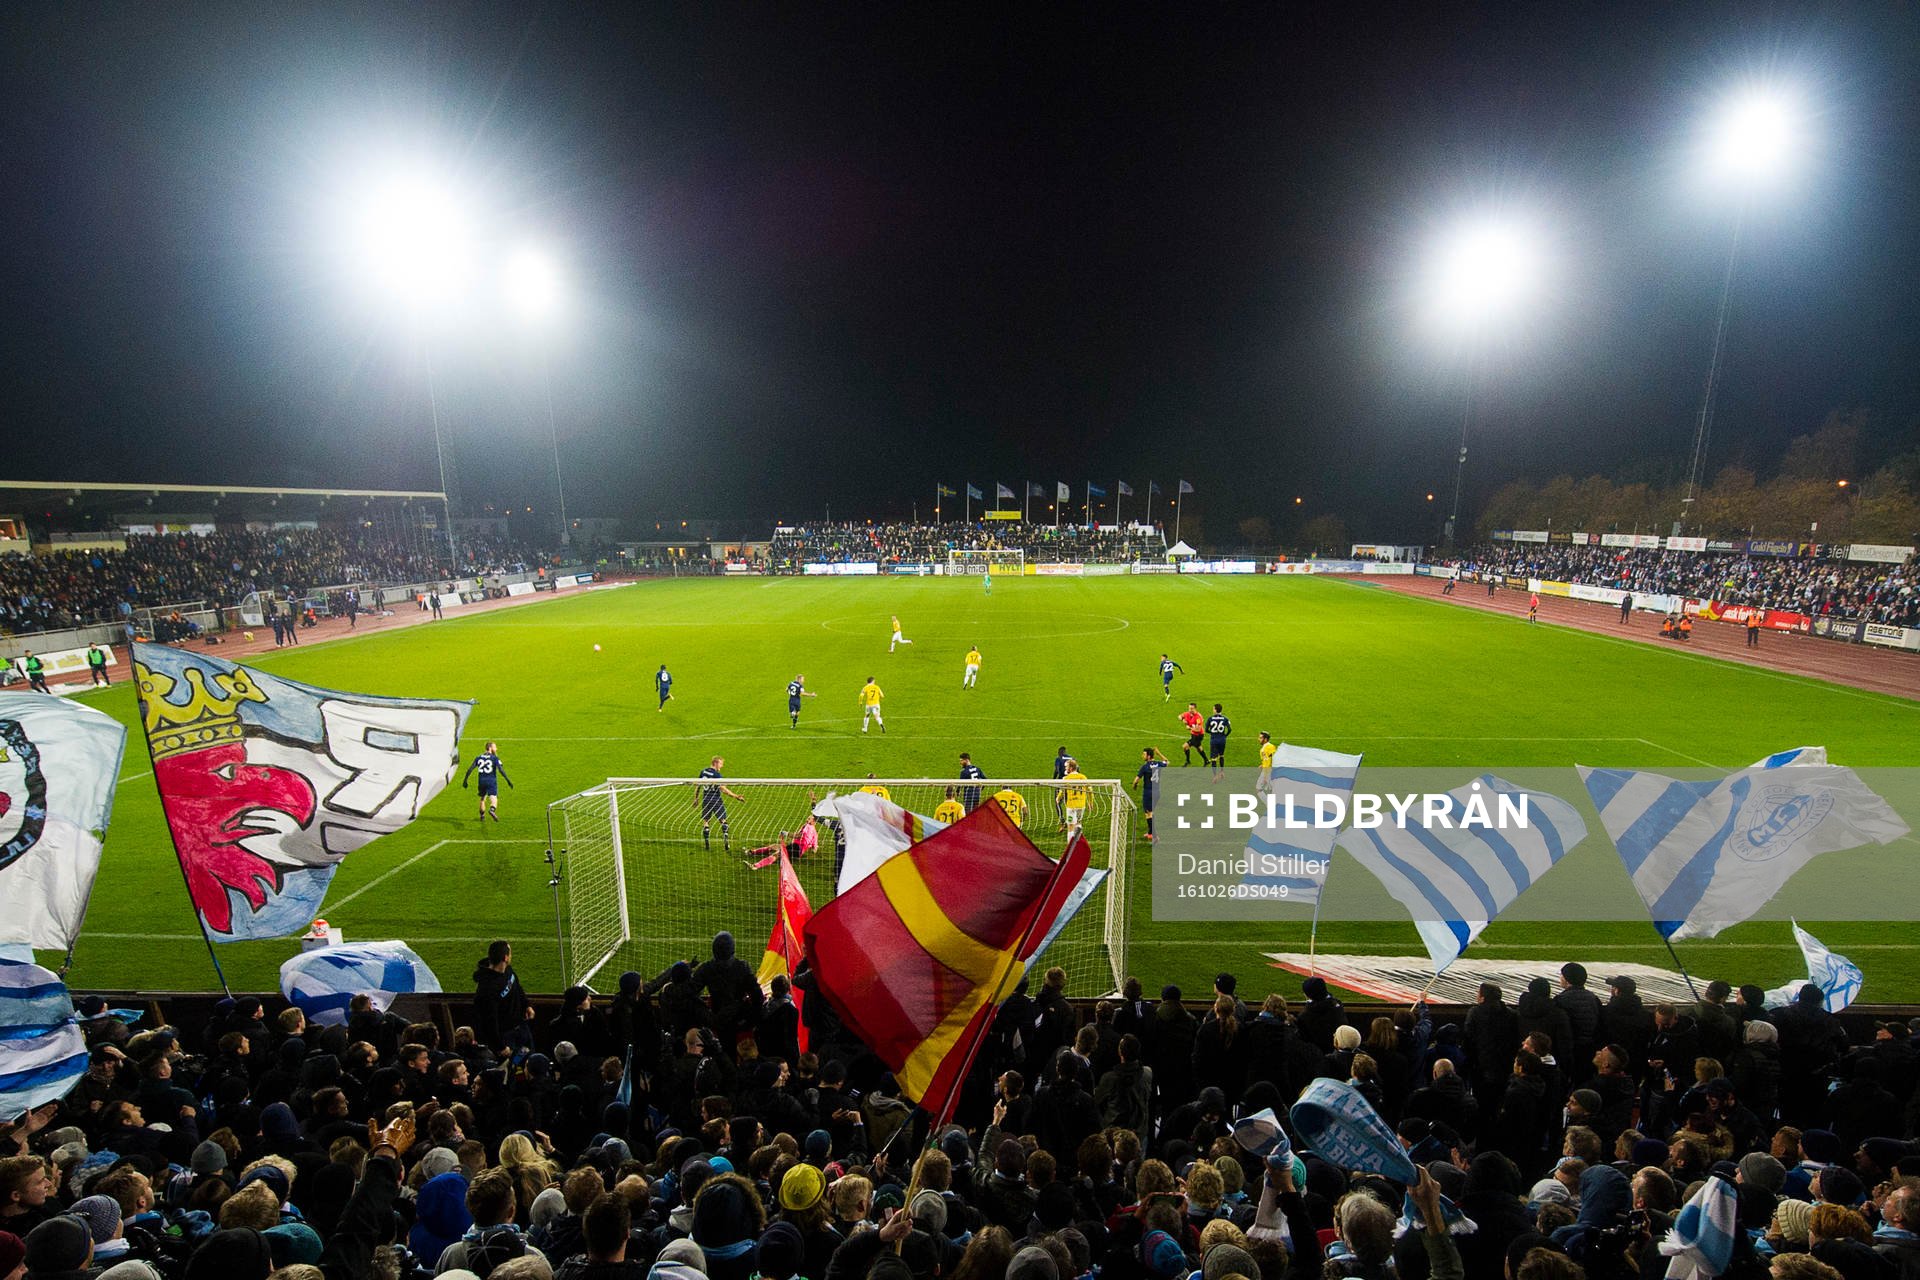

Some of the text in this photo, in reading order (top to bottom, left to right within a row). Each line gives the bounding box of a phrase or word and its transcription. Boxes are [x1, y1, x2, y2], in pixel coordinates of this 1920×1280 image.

[1831, 623, 1857, 634] FALCON
[1163, 662, 1174, 672] 22
[1210, 720, 1225, 733] 26
[477, 759, 493, 773] 23
